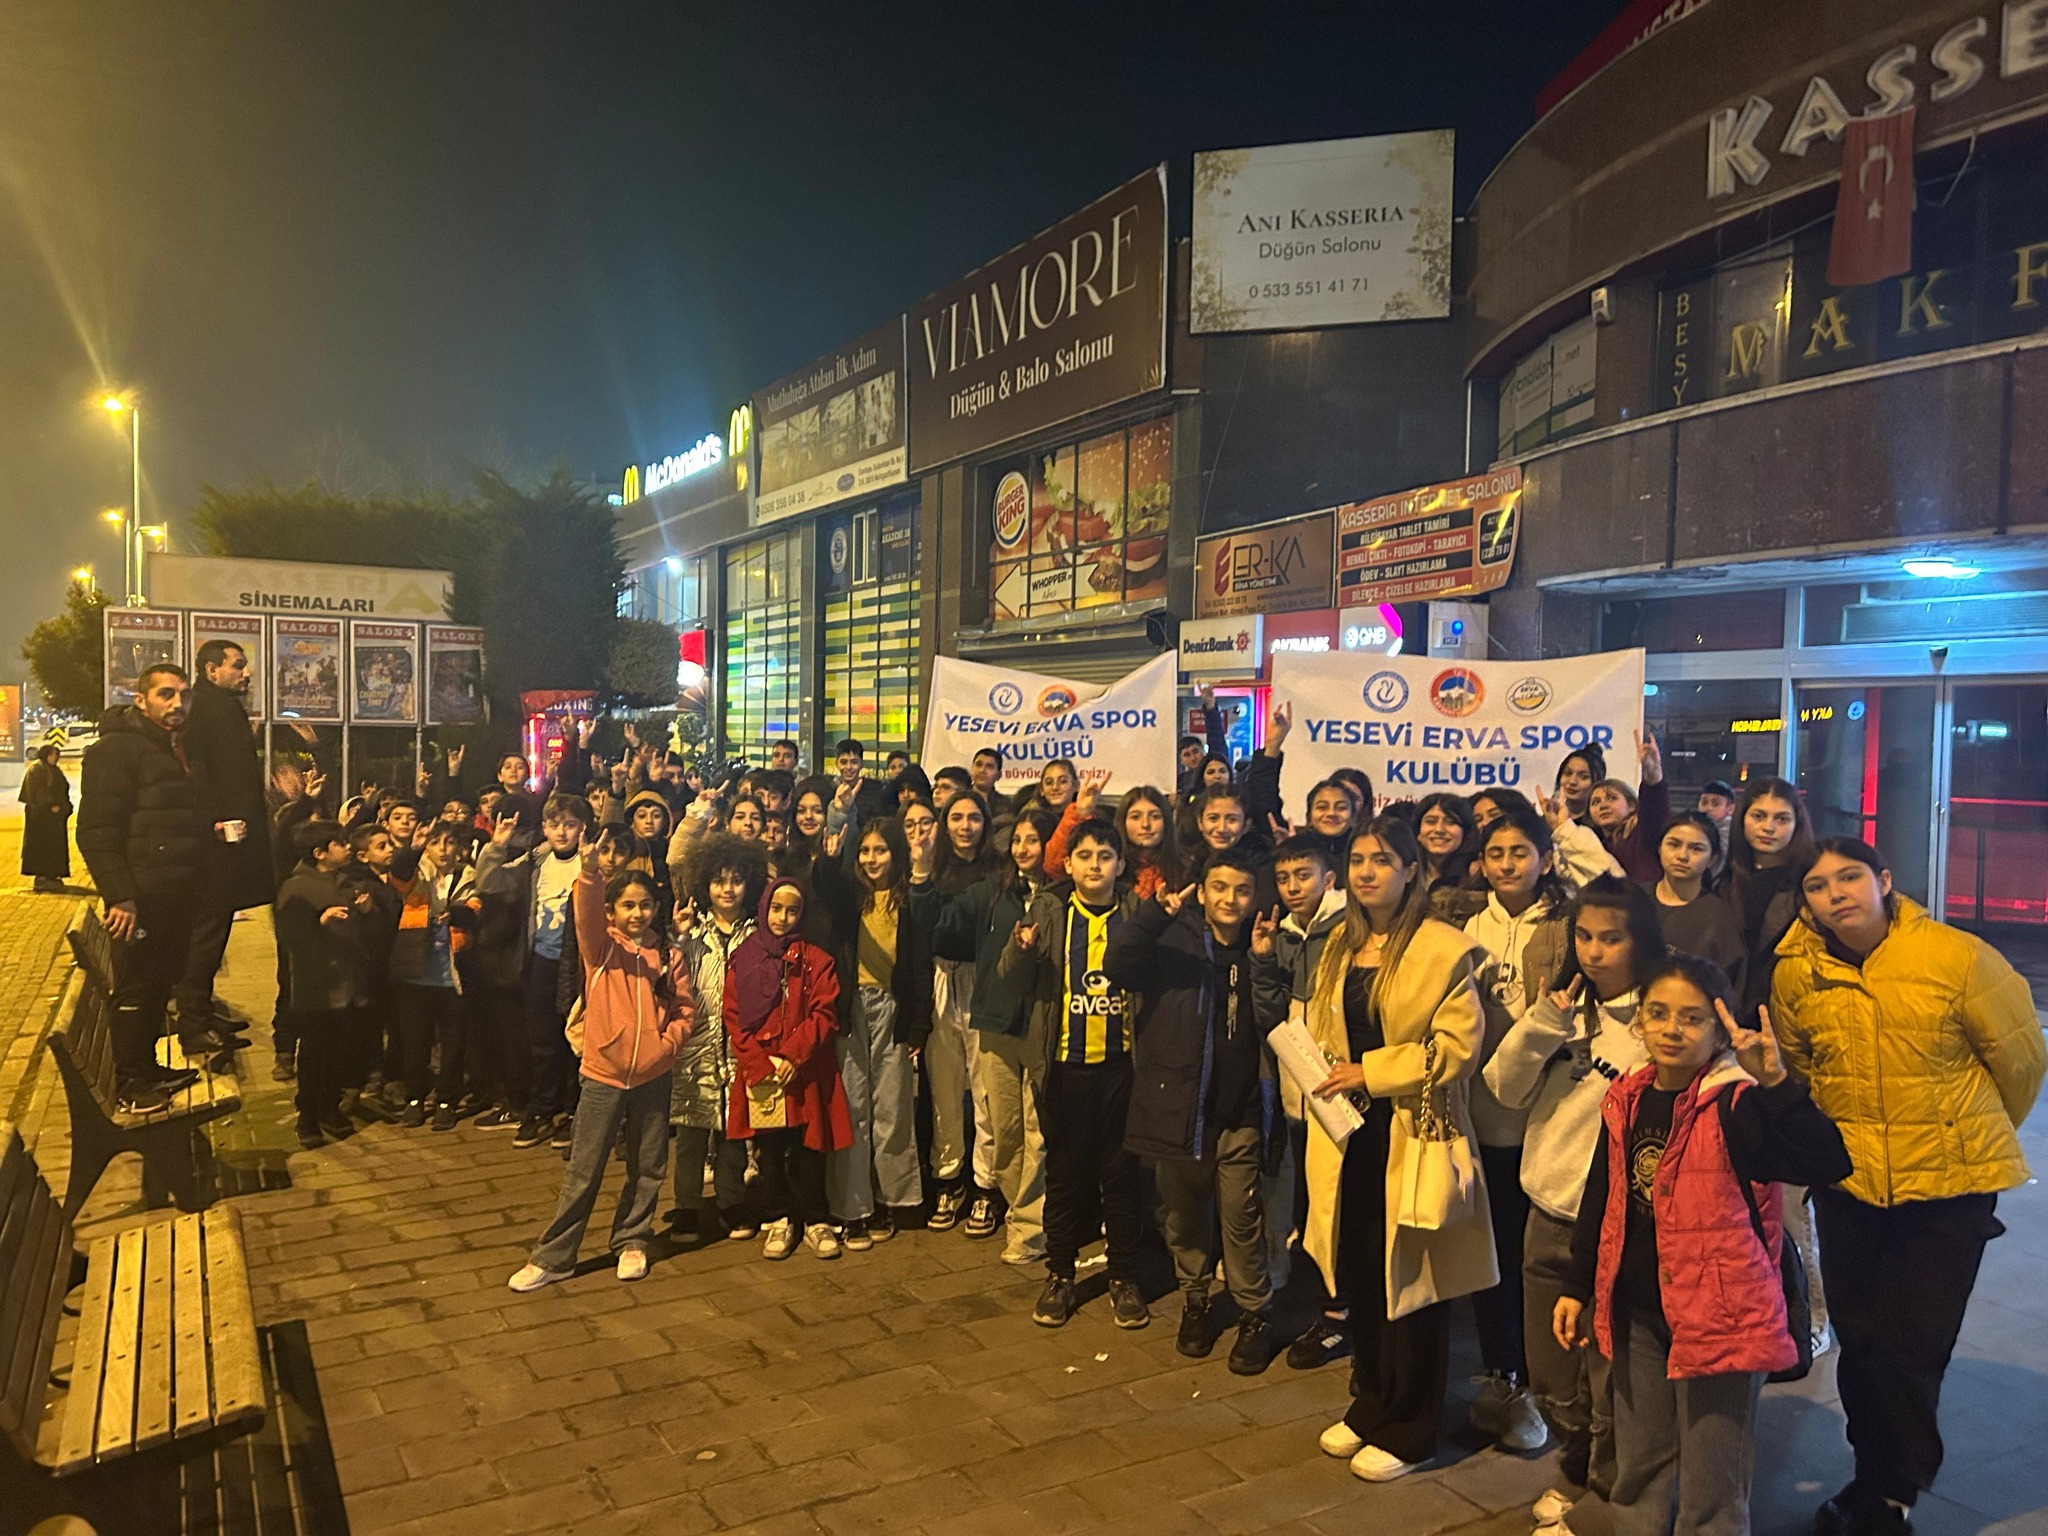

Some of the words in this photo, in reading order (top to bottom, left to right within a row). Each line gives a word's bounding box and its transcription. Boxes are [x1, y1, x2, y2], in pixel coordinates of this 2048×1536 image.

[1290, 205, 1405, 230] KASSERIA
[1259, 240, 1315, 261] Düğün
[1322, 236, 1382, 255] Salonu
[923, 205, 1140, 380] VIAMORE
[1249, 285, 1259, 299] 0
[1263, 282, 1290, 297] 533
[1295, 280, 1321, 295] 551
[1328, 278, 1345, 293] 41
[1352, 277, 1369, 292] 71
[950, 381, 995, 420] Düğün
[999, 369, 1011, 400] &
[1015, 356, 1050, 393] Balo
[1055, 333, 1114, 377] Salonu
[644, 432, 722, 496] McDonald's
[996, 484, 1024, 515] BURGER
[1401, 488, 1463, 517] İNTERET
[1467, 472, 1517, 501] SALONU
[997, 496, 1025, 531] KING
[1360, 527, 1398, 546] BİLGİSAYAR
[1399, 523, 1423, 538] TABLET
[1423, 517, 1450, 531] TAMİRİ
[1393, 543, 1426, 558] FOTOKOPİ
[1433, 534, 1467, 550] TARAYICI
[1233, 536, 1305, 585] ER-KA
[1360, 567, 1379, 583] ÖDEV
[1385, 564, 1405, 579] SLAYT
[1406, 557, 1448, 575] HAZIRLAMA
[1385, 582, 1413, 599] ÇİZELGE
[1414, 576, 1456, 594] HAZIRLAMA
[239, 590, 374, 613] SİNEMALARI
[111, 615, 166, 628] SALON
[197, 620, 248, 631] SALON
[251, 621, 259, 631] 2
[279, 622, 327, 633] SALON
[357, 626, 402, 637] SALON
[432, 631, 476, 642] SALON
[1183, 635, 1235, 655] DenizBank
[1023, 714, 1085, 736] ERVA
[1091, 709, 1157, 730] SPOR
[996, 735, 1094, 762] KULÜBÜ
[1422, 726, 1519, 750] ERVA
[1520, 724, 1614, 750] SPOR
[1004, 766, 1041, 779] BÜYÜK
[1386, 756, 1521, 786] KULÜBÜ
[1070, 994, 1123, 1016] avea
